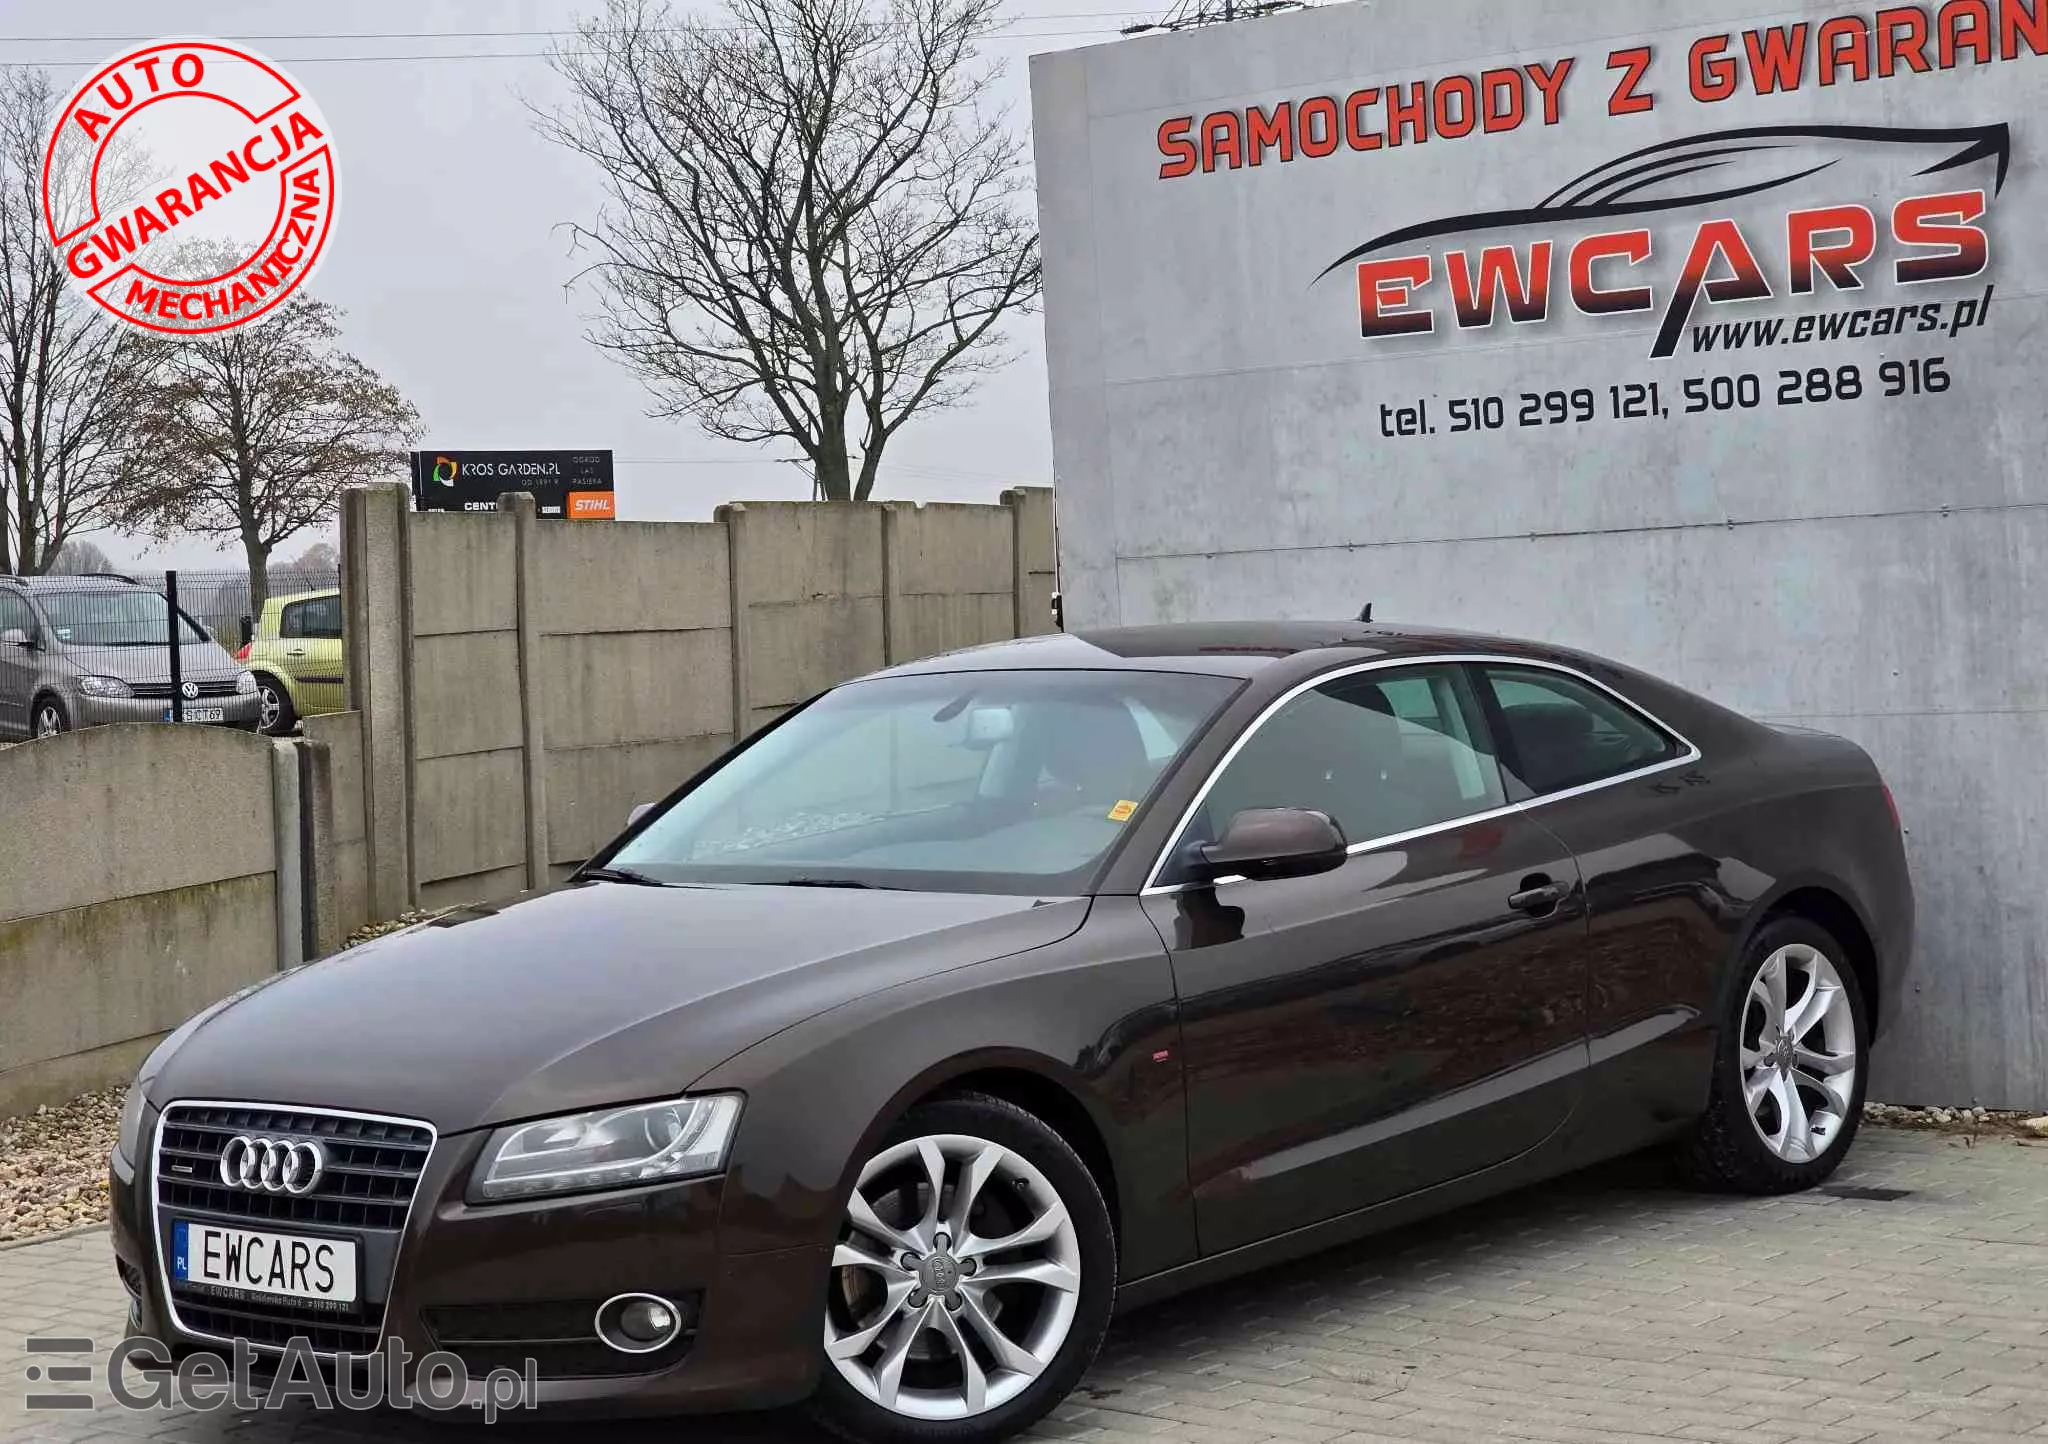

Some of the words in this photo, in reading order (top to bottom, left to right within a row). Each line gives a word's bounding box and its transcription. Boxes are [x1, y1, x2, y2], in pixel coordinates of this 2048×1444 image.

[1157, 57, 1575, 179] SAMOCHODY
[1606, 46, 1654, 117] Z
[1356, 190, 1990, 360] EWCARS
[1692, 284, 1995, 353] www.ewcars.pl
[1380, 399, 1436, 437] tel.
[1448, 396, 1504, 433] 510
[1518, 388, 1594, 427] 299
[1609, 381, 1669, 420] 121,
[1683, 373, 1761, 414] 500
[1776, 364, 1862, 406] 288
[1878, 356, 1951, 397] 916
[461, 463, 494, 476] KROS
[498, 462, 560, 476] GARDEN.PL
[464, 502, 498, 511] CENT
[575, 499, 610, 512] STIHL
[177, 1256, 187, 1271] PL
[203, 1230, 335, 1293] EWCARS
